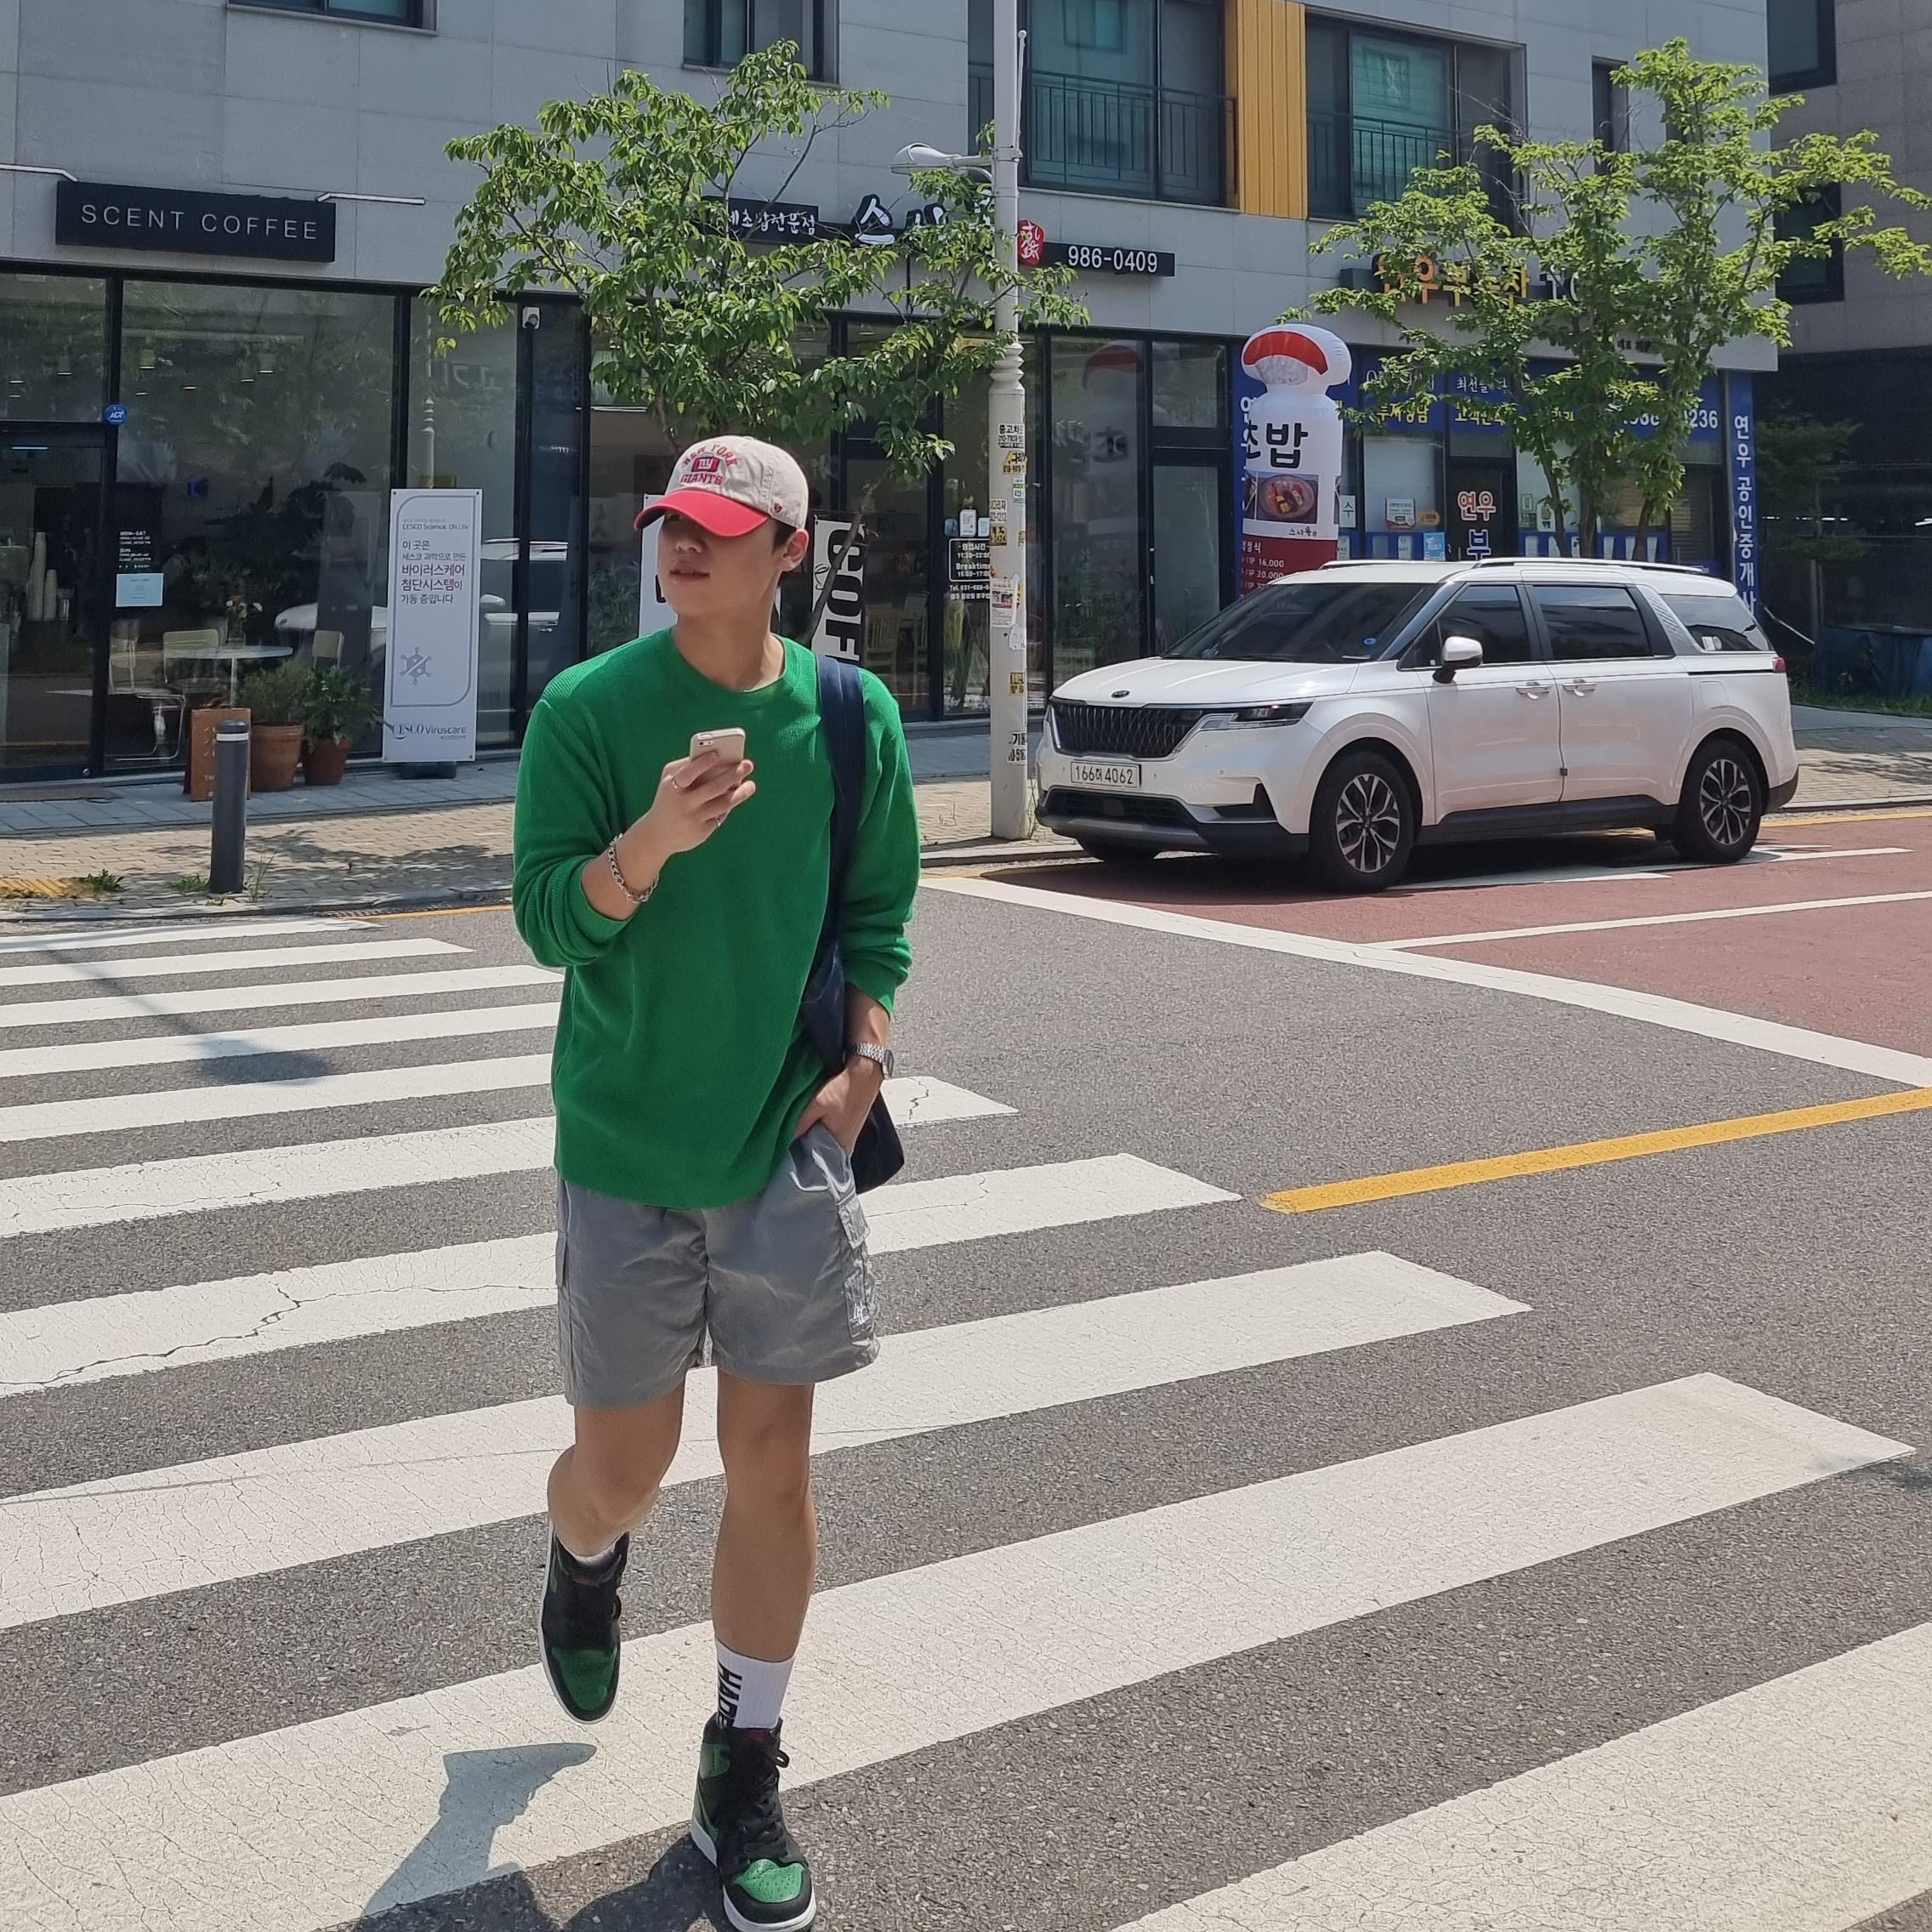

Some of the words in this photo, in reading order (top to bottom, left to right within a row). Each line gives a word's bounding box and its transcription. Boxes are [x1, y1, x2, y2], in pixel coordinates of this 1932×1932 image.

[81, 204, 185, 230] SCENT
[202, 213, 316, 240] COFFEE
[1068, 245, 1158, 273] 986-0409
[1734, 415, 1752, 469] 연우
[710, 444, 738, 467] YORK
[679, 473, 724, 486] GIANTS
[1457, 491, 1497, 521] 연우
[413, 540, 430, 551] 곳은
[401, 564, 465, 577] 바이러스케어
[401, 578, 463, 592] 첨단시스템이
[420, 594, 454, 605] 중입니다
[824, 529, 866, 662] COF
[425, 725, 467, 735] Viruscare
